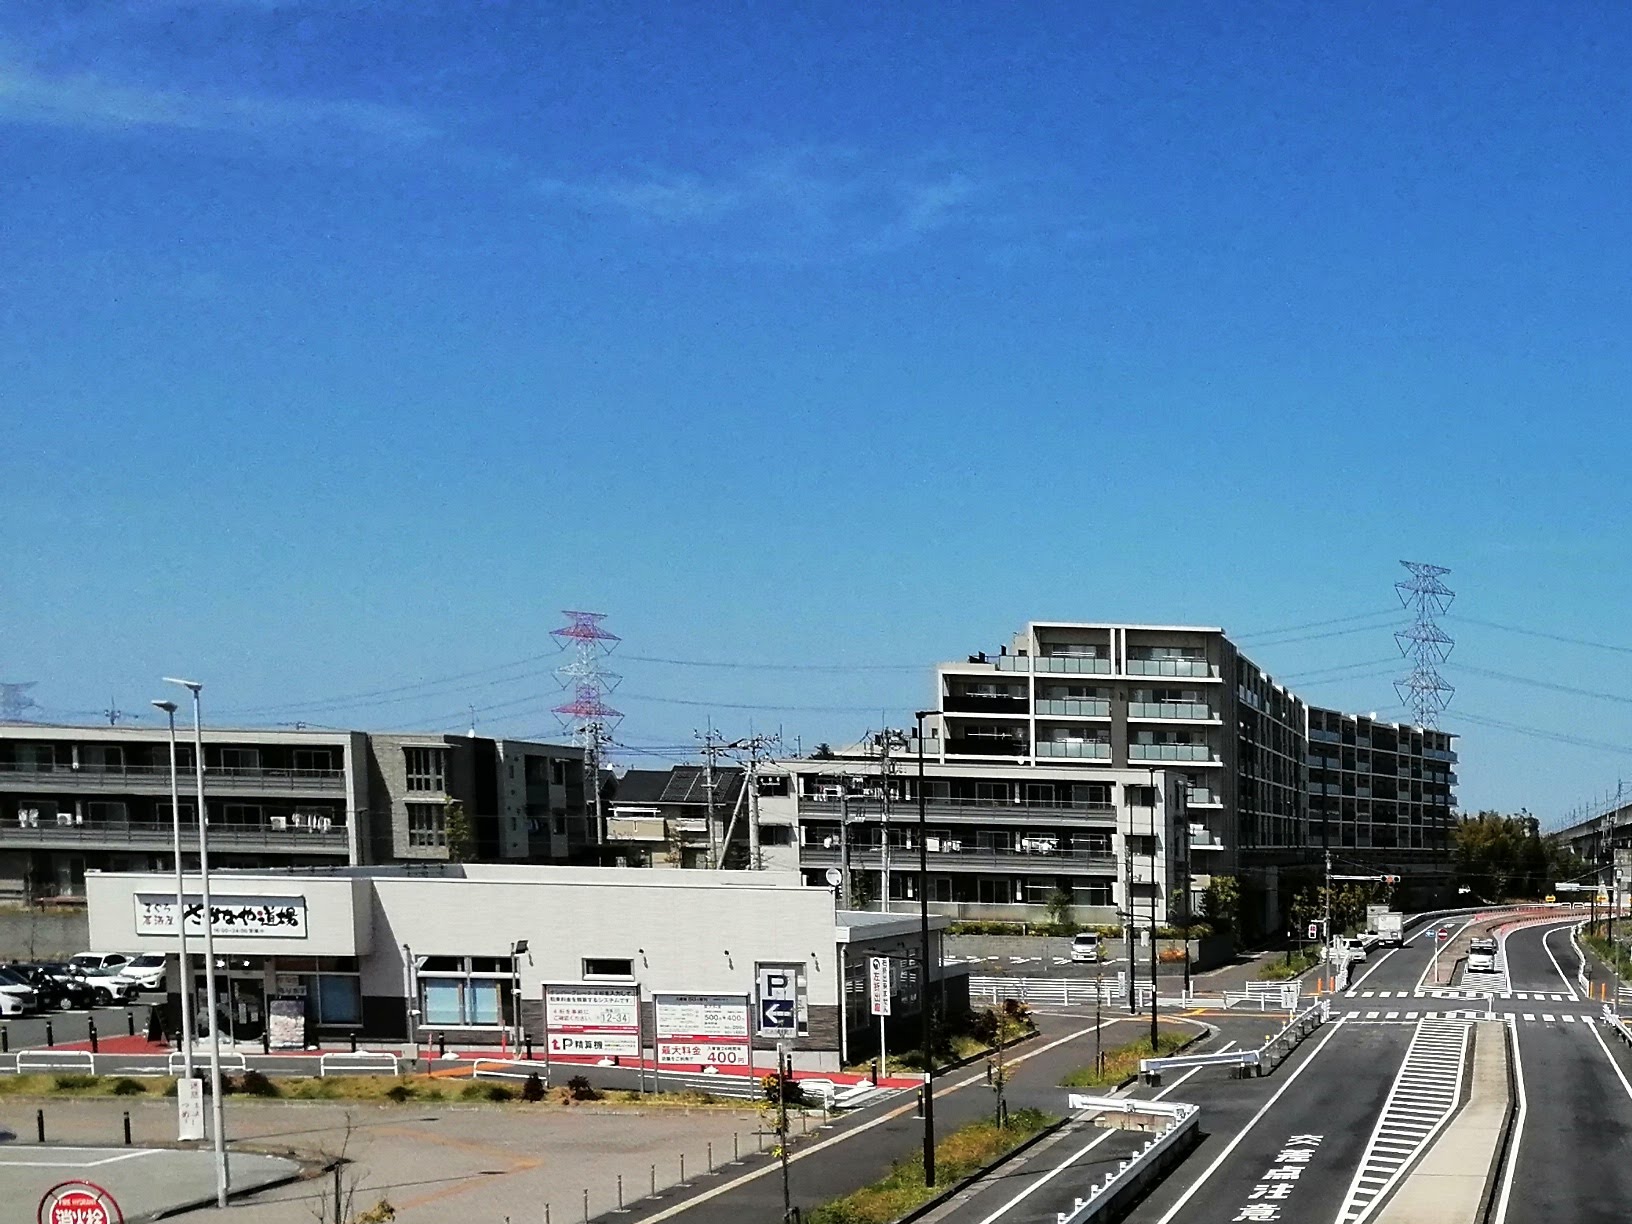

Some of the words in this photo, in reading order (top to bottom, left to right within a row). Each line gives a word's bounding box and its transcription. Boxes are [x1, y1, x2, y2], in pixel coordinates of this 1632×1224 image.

[767, 974, 788, 997] P
[602, 1013, 627, 1022] 12-34
[661, 1045, 702, 1055] 最大料金
[1231, 1134, 1324, 1222] 交差点注意
